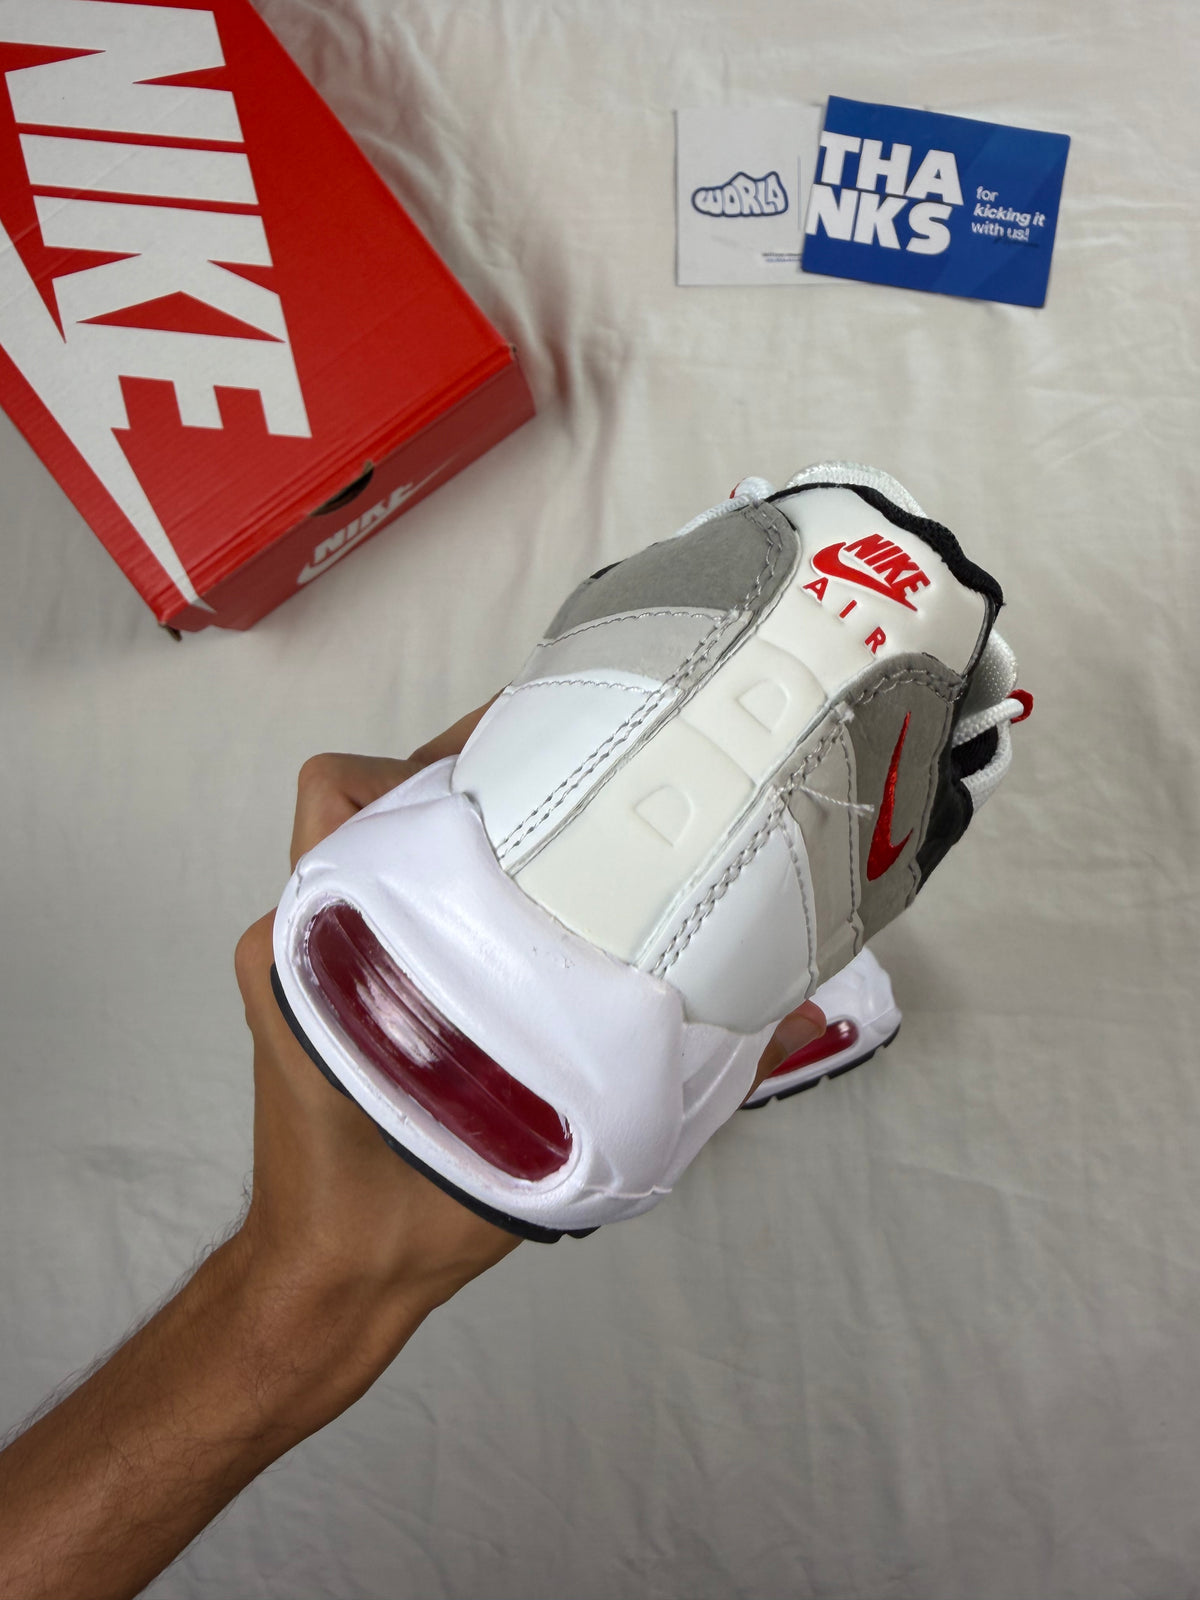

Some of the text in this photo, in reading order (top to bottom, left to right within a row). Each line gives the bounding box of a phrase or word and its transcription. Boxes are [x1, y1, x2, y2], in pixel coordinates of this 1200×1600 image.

[819, 130, 964, 206] THA
[976, 186, 999, 202] for
[0, 0, 312, 439] NIKE
[805, 183, 953, 256] NKS
[971, 221, 1030, 242] with us!
[973, 203, 1046, 227] kicking it
[313, 481, 414, 564] NIKE
[843, 533, 931, 602] NIKE
[802, 576, 887, 655] AIR
